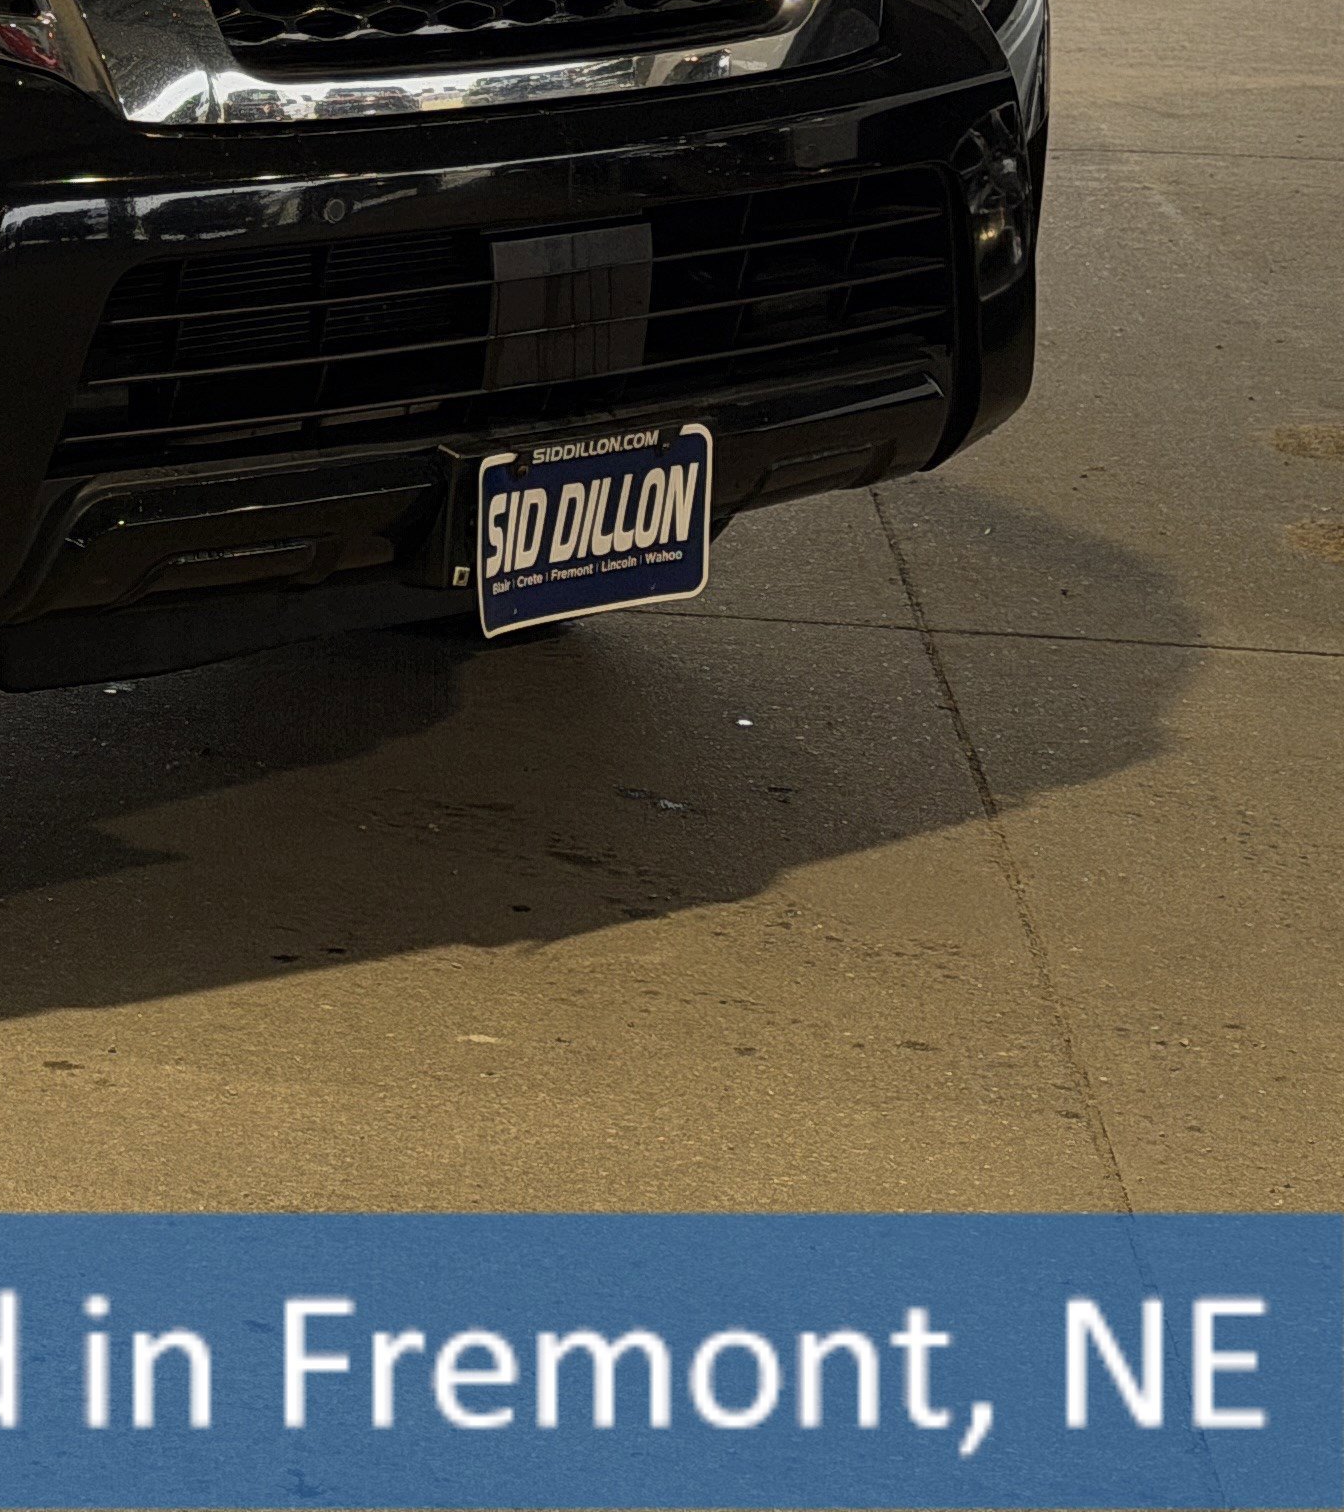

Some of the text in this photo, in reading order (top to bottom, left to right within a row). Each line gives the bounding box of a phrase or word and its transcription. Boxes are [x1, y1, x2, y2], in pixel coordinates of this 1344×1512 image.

[532, 430, 660, 465] SIDDILLON.COM
[486, 461, 700, 579] SID DILLON
[492, 548, 684, 596] Blair Crete Fremont Lincoln Wahoo
